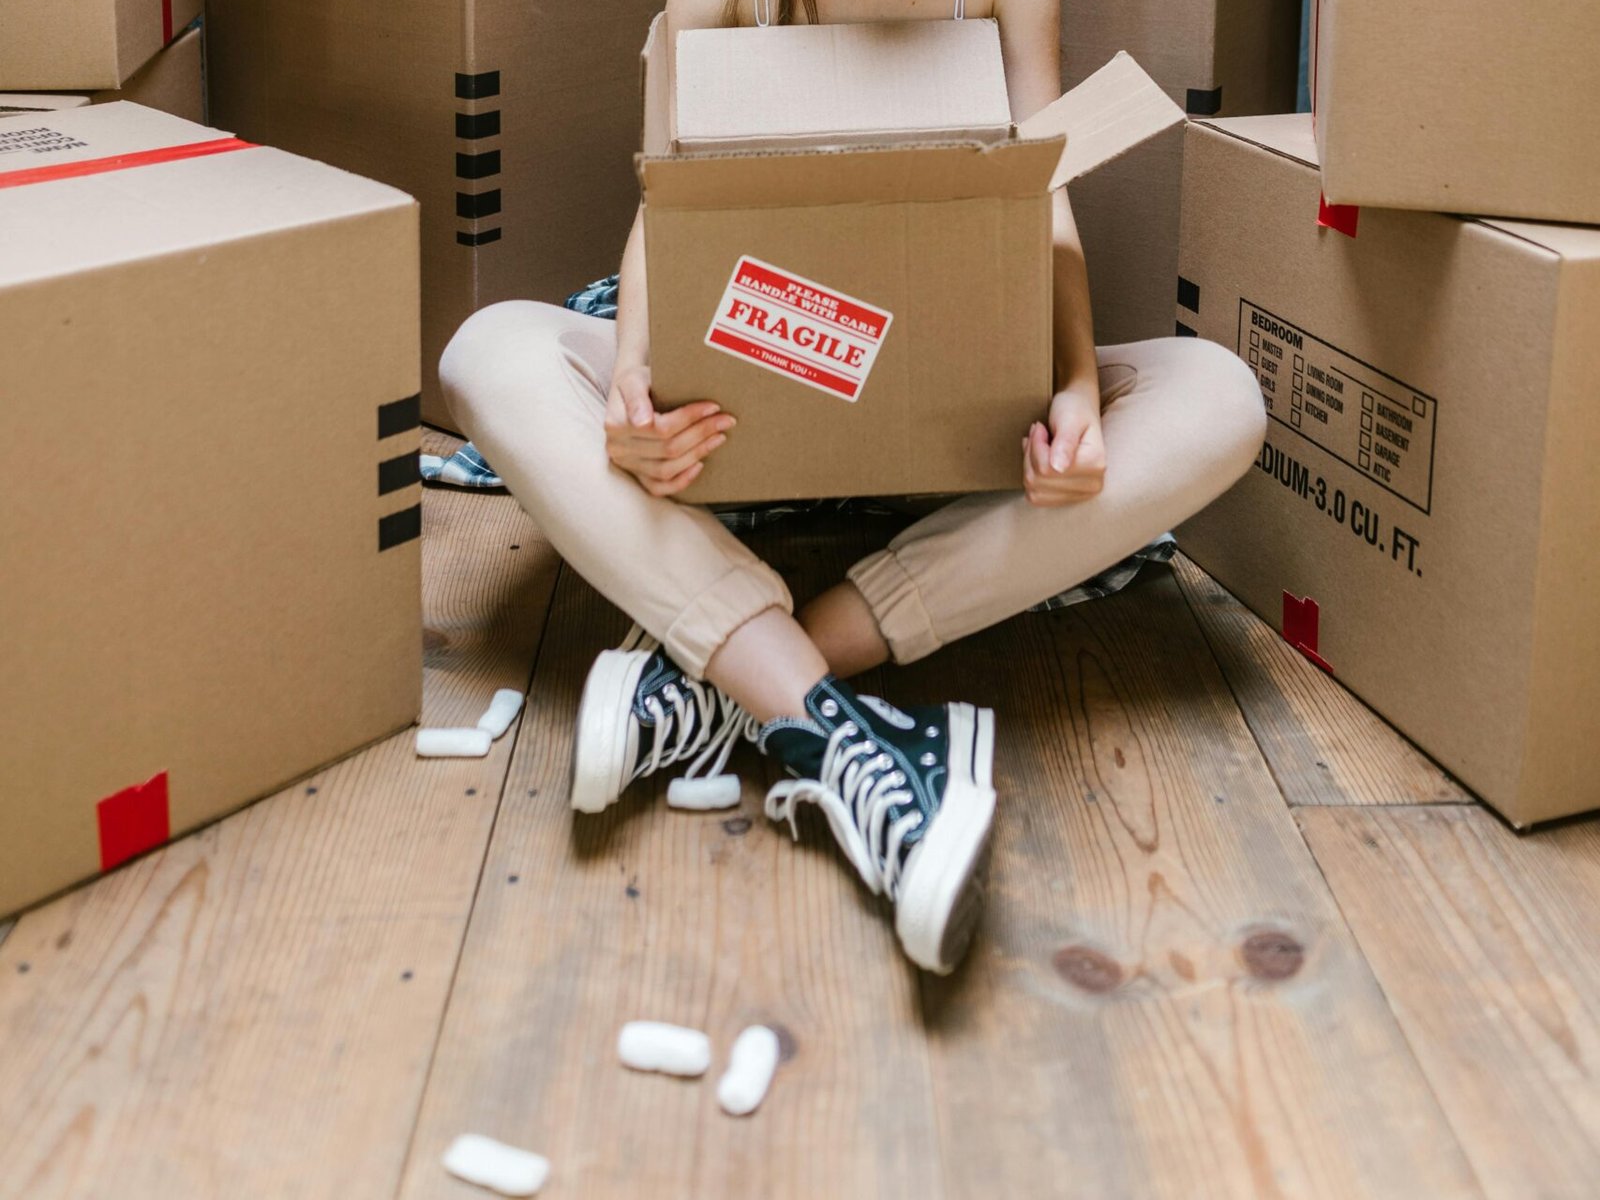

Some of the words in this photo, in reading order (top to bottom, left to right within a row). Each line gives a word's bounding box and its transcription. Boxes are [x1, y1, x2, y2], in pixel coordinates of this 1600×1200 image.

[29, 141, 88, 153] NAME
[740, 275, 797, 304] HANDLE
[801, 298, 836, 320] WITH
[839, 314, 877, 336] CARE
[786, 283, 839, 311] PLEASE
[726, 298, 866, 368] FRAGILE
[1252, 311, 1303, 350] BEDROOM
[761, 350, 788, 368] THANK
[790, 362, 808, 376] YOU
[1262, 339, 1283, 360] MASTER
[1261, 357, 1278, 373] GUEST
[1307, 364, 1325, 383] LIVING
[1325, 375, 1344, 394] ROOM
[1260, 374, 1275, 393] GIRLS
[1306, 383, 1325, 402] DINING
[1325, 394, 1344, 414] ROOM
[1305, 402, 1328, 424] KITCHEN
[1377, 403, 1413, 433] BATHROOM
[1376, 423, 1409, 451] BASEMENT
[1374, 442, 1400, 468] GARAGE
[1373, 462, 1391, 482] ATTIC
[1351, 500, 1384, 552] CU.
[1392, 526, 1422, 578] FT.
